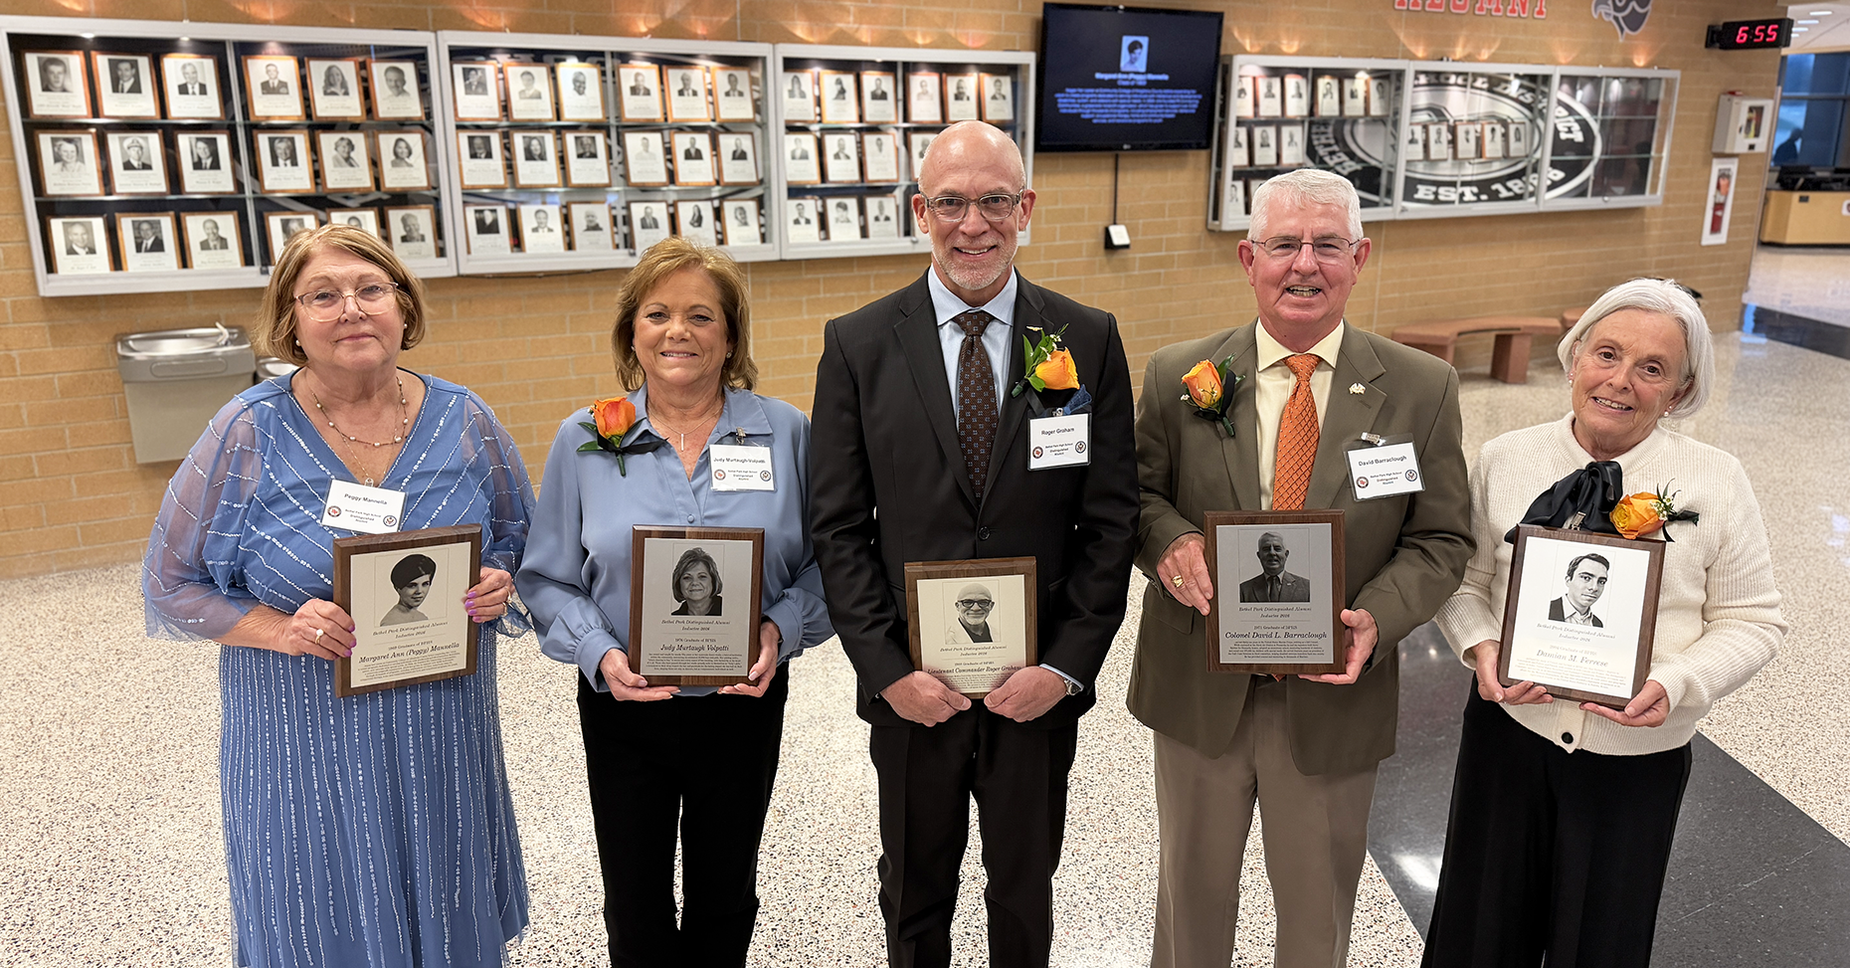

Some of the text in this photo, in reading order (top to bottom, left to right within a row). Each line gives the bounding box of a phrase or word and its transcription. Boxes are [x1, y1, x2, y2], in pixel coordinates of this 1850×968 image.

[1736, 24, 1778, 43] 6:55
[1414, 184, 1488, 201] EST.
[1375, 456, 1407, 464] Barraclough
[1284, 631, 1327, 640] Barraclough
[359, 653, 390, 663] Margaret
[406, 647, 429, 656] (Peggy)
[430, 642, 460, 652] Mannella
[660, 644, 675, 652] Judy
[676, 644, 705, 652] Murtaugh
[1537, 649, 1567, 660] Damian
[1580, 656, 1608, 667] Ferrese
